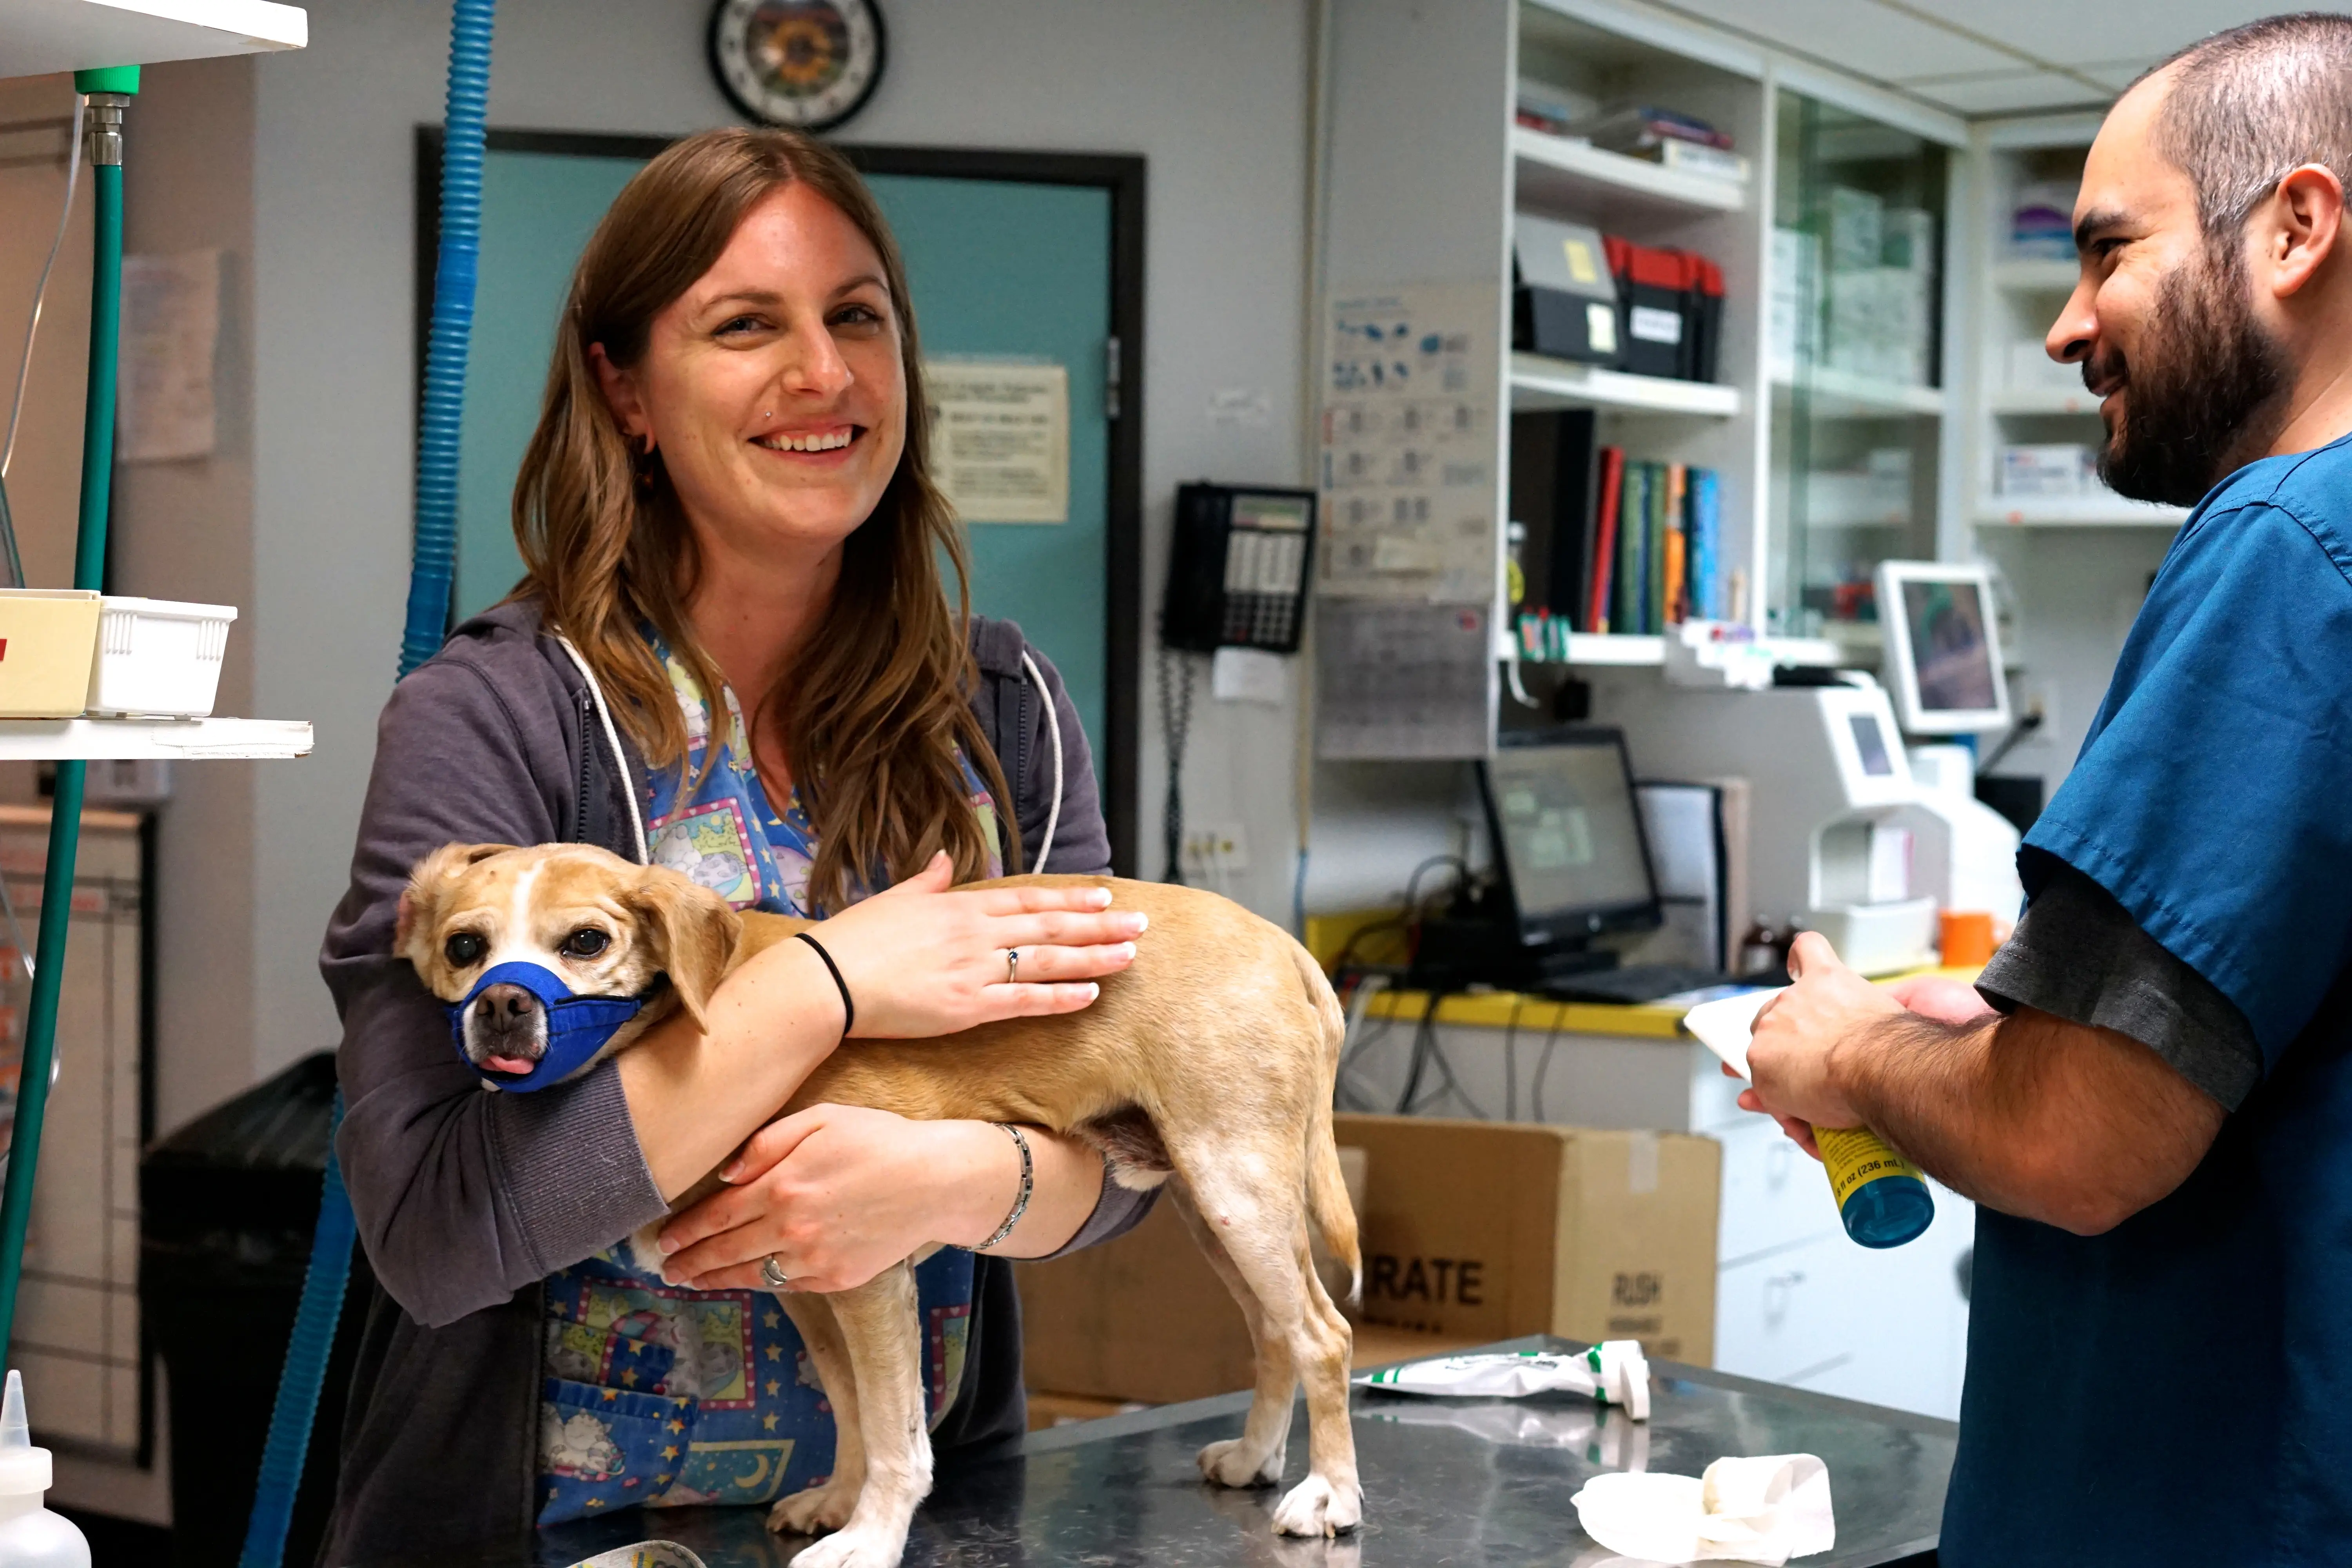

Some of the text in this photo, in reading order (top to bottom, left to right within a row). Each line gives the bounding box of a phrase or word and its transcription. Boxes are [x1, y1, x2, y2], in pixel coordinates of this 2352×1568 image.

[1840, 1180, 1846, 1190] fl
[1847, 1172, 1857, 1184] oz
[1857, 1160, 1881, 1177] (236
[1364, 1256, 1483, 1305] RATE
